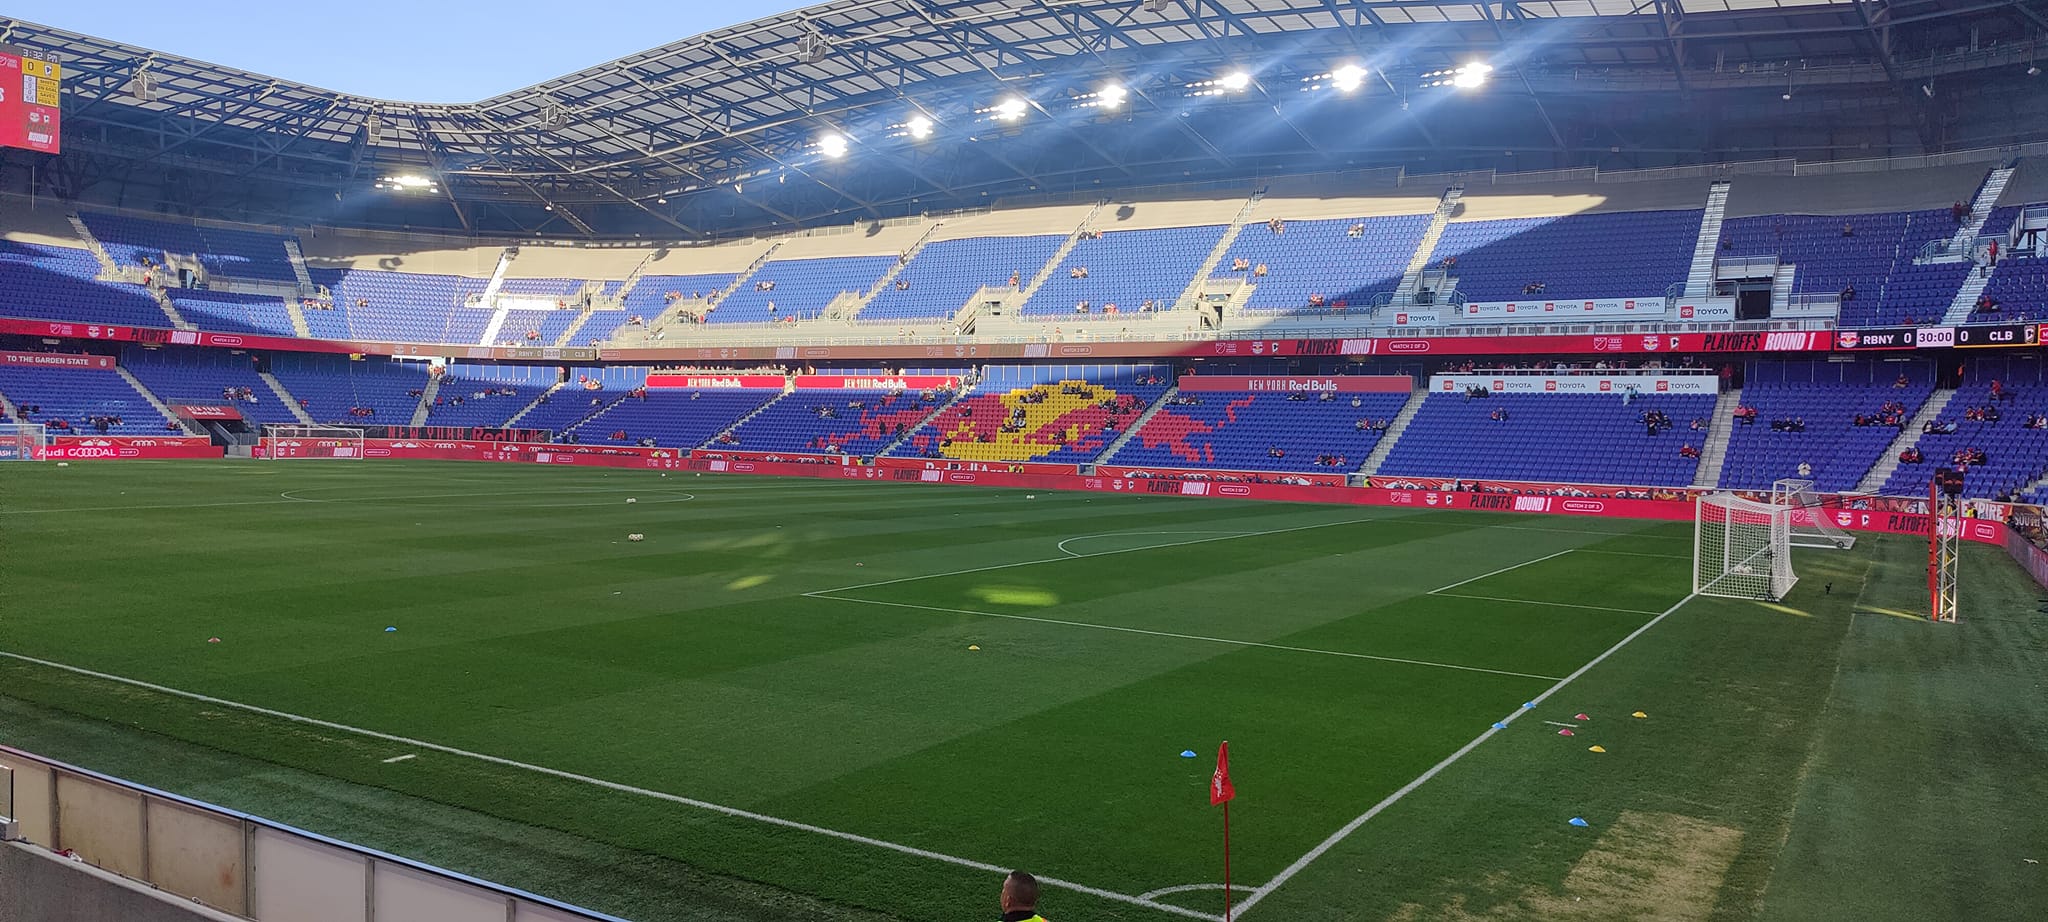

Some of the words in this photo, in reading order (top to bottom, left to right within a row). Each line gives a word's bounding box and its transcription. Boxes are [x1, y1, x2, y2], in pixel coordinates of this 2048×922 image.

[23, 49, 43, 60] 3:32
[28, 61, 34, 71] 0
[1703, 333, 1761, 351] PLAYOFFS
[1764, 332, 1806, 350] ROUND
[1807, 332, 1815, 350] 1
[1863, 334, 1894, 345] RBNY
[1903, 332, 1912, 344] 0
[1919, 332, 1952, 343] 30:00
[1960, 330, 1969, 342] 0
[1989, 331, 2013, 341] CLB
[1296, 339, 1338, 354] PLAYOFFS
[1340, 339, 1371, 354] ROUND
[19, 355, 33, 363] THE
[35, 356, 65, 364] GARDEN
[1248, 379, 1264, 391] NEW
[1266, 379, 1286, 391] YORK
[1288, 379, 1310, 391] Red
[1311, 379, 1338, 391] Bulls
[471, 427, 505, 442] Red
[37, 447, 64, 457] Audi
[1147, 480, 1180, 493] PLAYOFFS
[1182, 482, 1205, 495] ROUND
[1470, 494, 1512, 509] PLAYOFFS
[1514, 496, 1545, 511] ROUND
[1961, 501, 2005, 521] EPIRE
[1888, 514, 1931, 532] PLAYOFF
